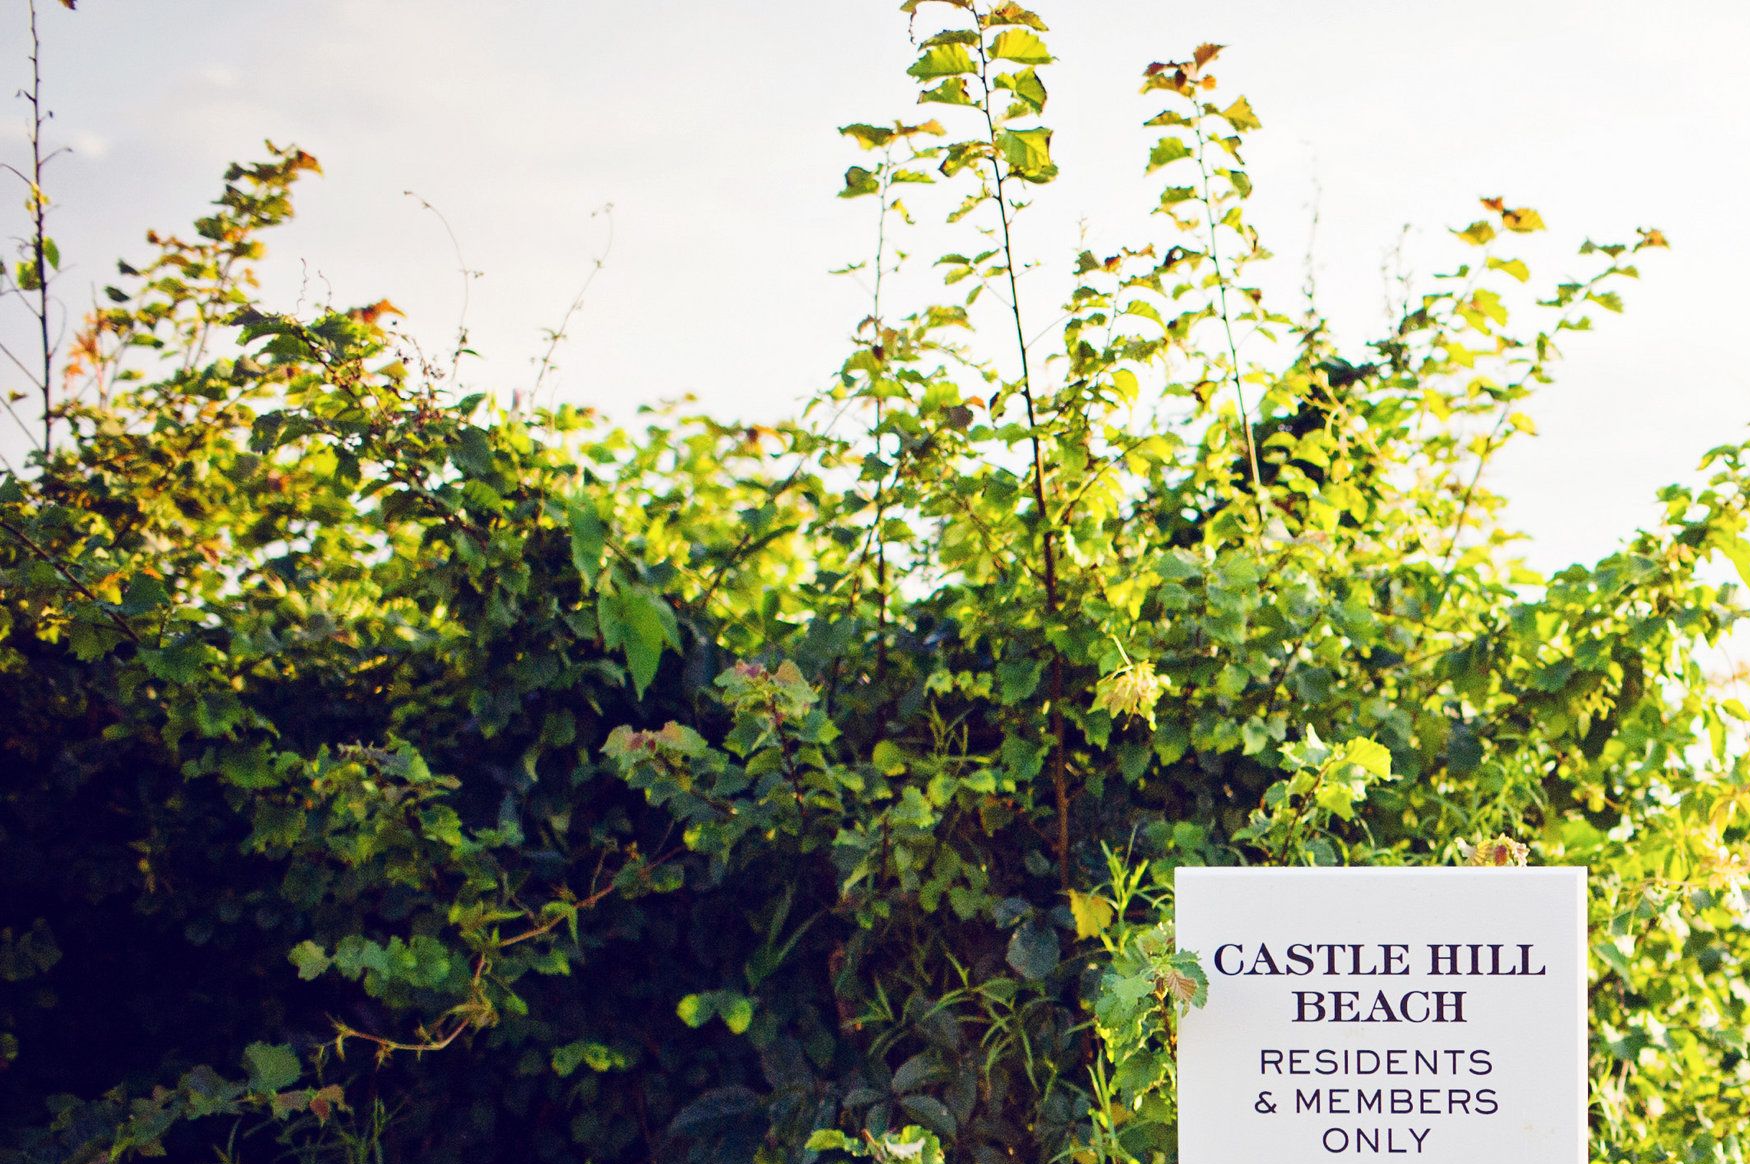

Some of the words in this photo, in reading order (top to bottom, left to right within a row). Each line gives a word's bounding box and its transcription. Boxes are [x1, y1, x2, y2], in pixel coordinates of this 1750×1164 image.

[1213, 943, 1410, 976] CASTLE
[1426, 943, 1547, 976] HILL
[1291, 989, 1468, 1023] BEACH
[1260, 1049, 1493, 1076] RESIDENTS
[1254, 1090, 1278, 1115] &
[1296, 1088, 1499, 1115] MEMBERS
[1322, 1127, 1432, 1154] ONLY
